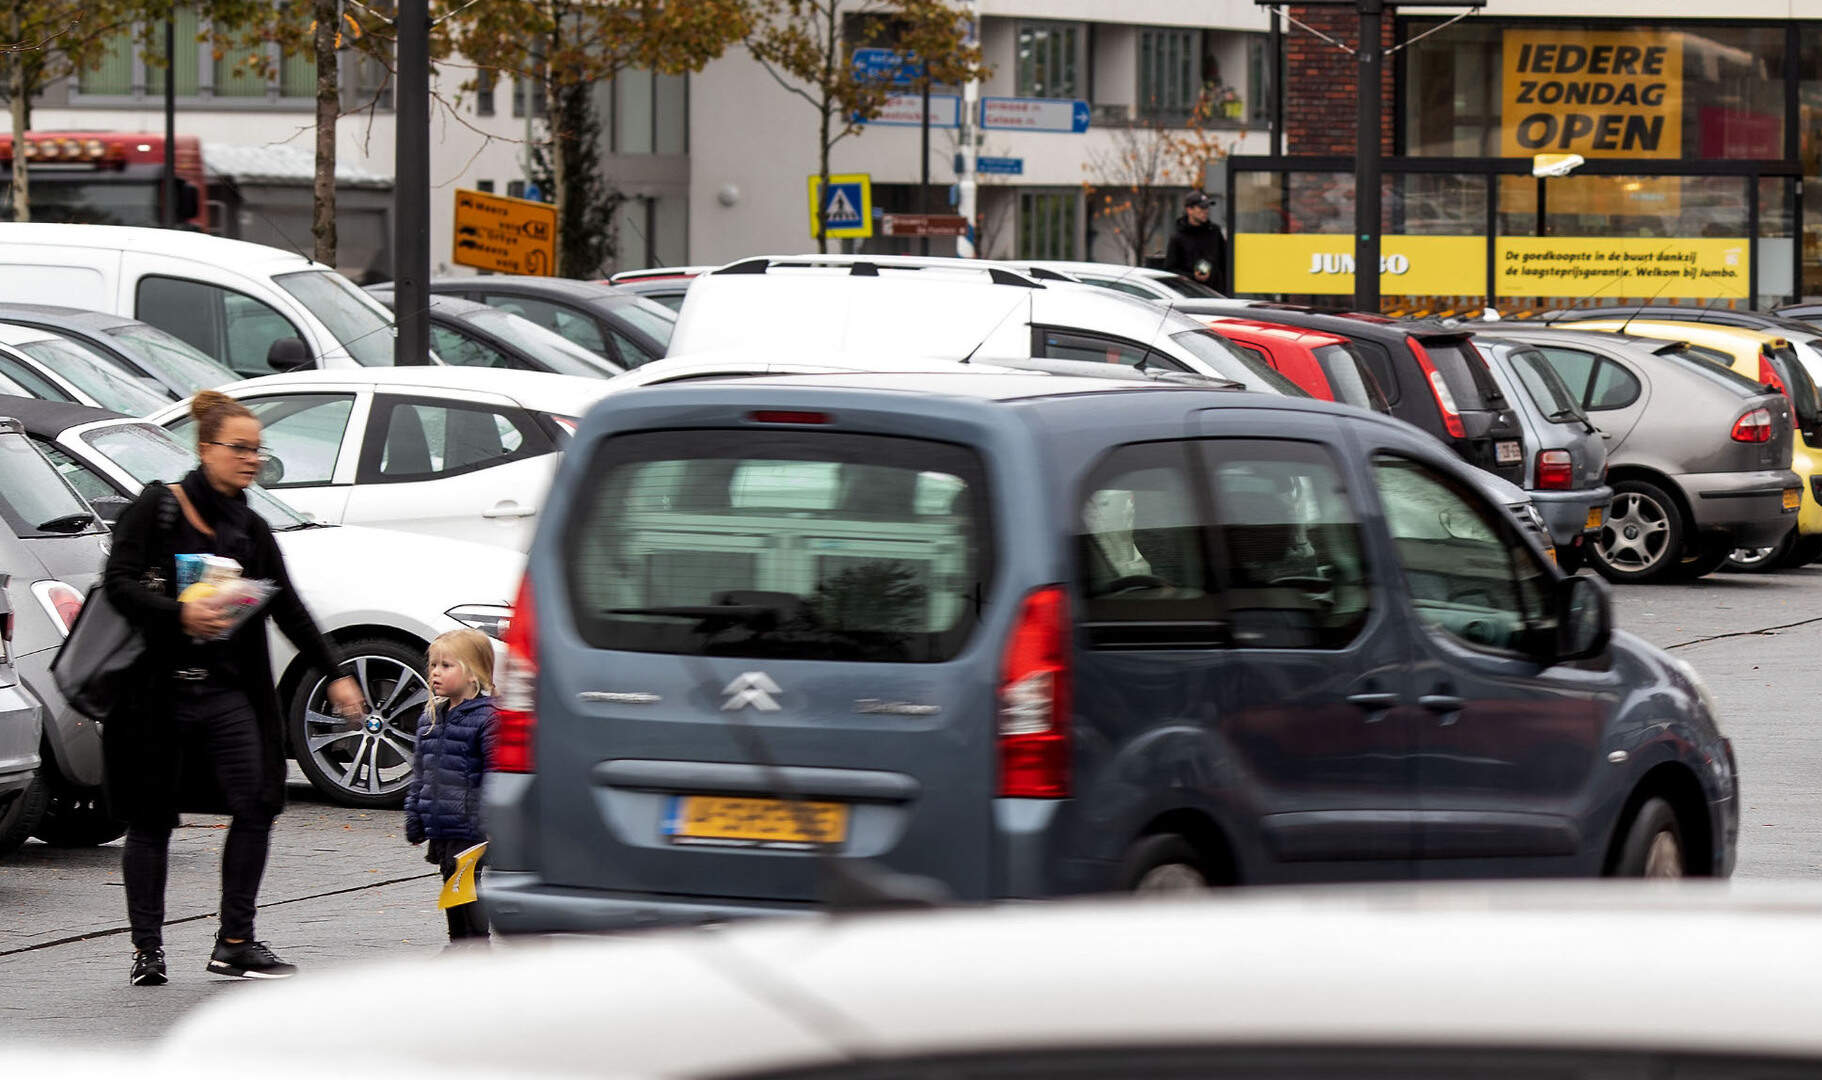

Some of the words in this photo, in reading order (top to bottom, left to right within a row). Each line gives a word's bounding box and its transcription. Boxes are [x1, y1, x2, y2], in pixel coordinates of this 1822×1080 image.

[1516, 44, 1667, 75] IEDERE
[1516, 81, 1667, 106] ZONDAG
[1516, 113, 1665, 151] OPEN
[1505, 251, 1519, 260] De
[1522, 251, 1592, 264] goedkoopste
[1594, 251, 1605, 261] in
[1608, 251, 1621, 261] de
[1623, 252, 1653, 262] buurt
[1656, 252, 1697, 265] dankzij
[1505, 266, 1518, 276] de
[1636, 267, 1681, 277] Welkom
[1683, 267, 1698, 280] bij
